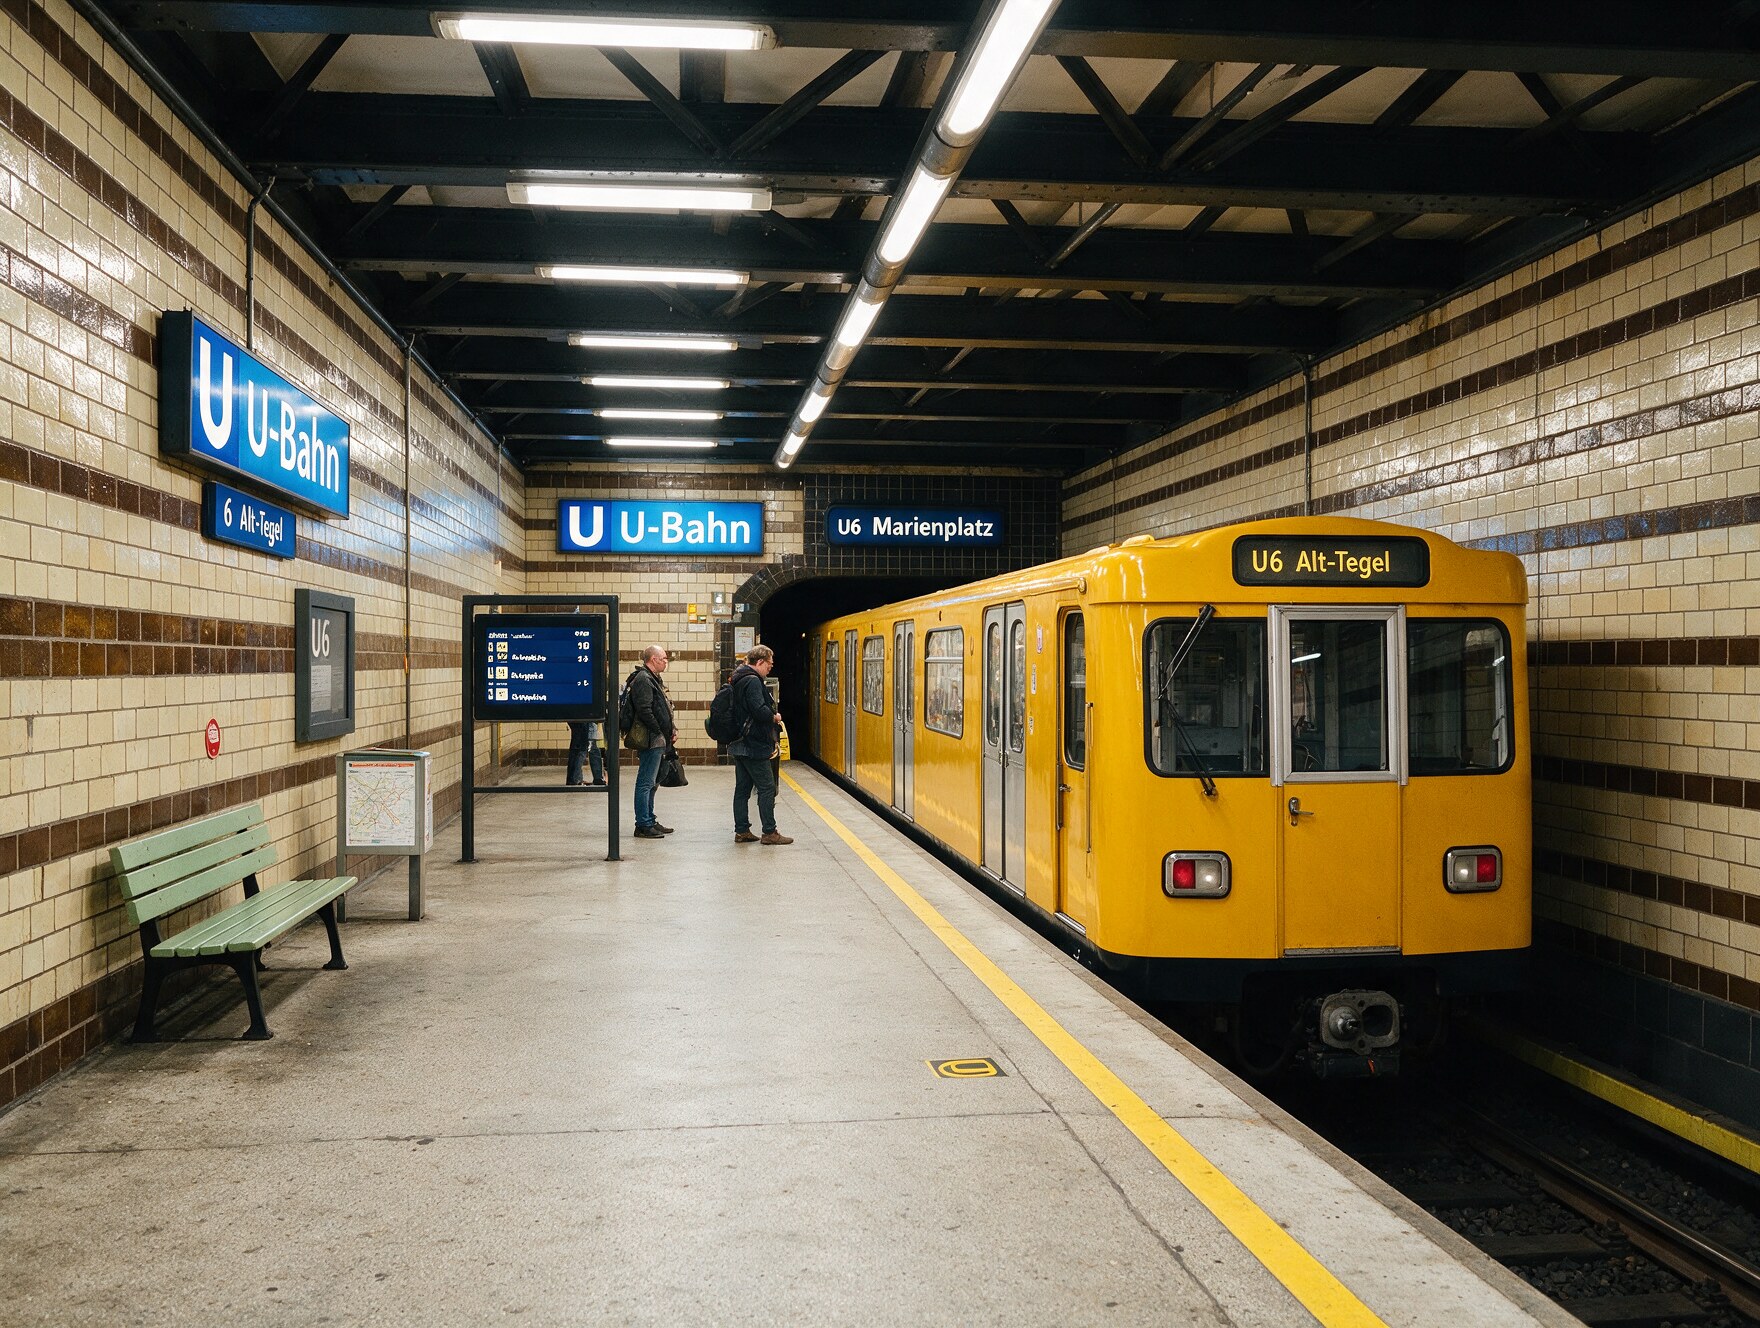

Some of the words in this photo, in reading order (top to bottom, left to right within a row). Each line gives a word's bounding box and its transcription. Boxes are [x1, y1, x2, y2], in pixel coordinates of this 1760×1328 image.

[200, 336, 232, 449] U
[249, 379, 339, 493] U-Bahn
[224, 498, 232, 527] 6
[240, 504, 283, 547] Alt-Tegel
[569, 505, 604, 547] U
[620, 511, 751, 544] U-Bahn
[838, 518, 861, 536] U6
[872, 516, 994, 541] Marienplatz
[1252, 550, 1283, 573] U6
[1296, 550, 1390, 579] Alt-Tegel
[311, 618, 330, 658] U6
